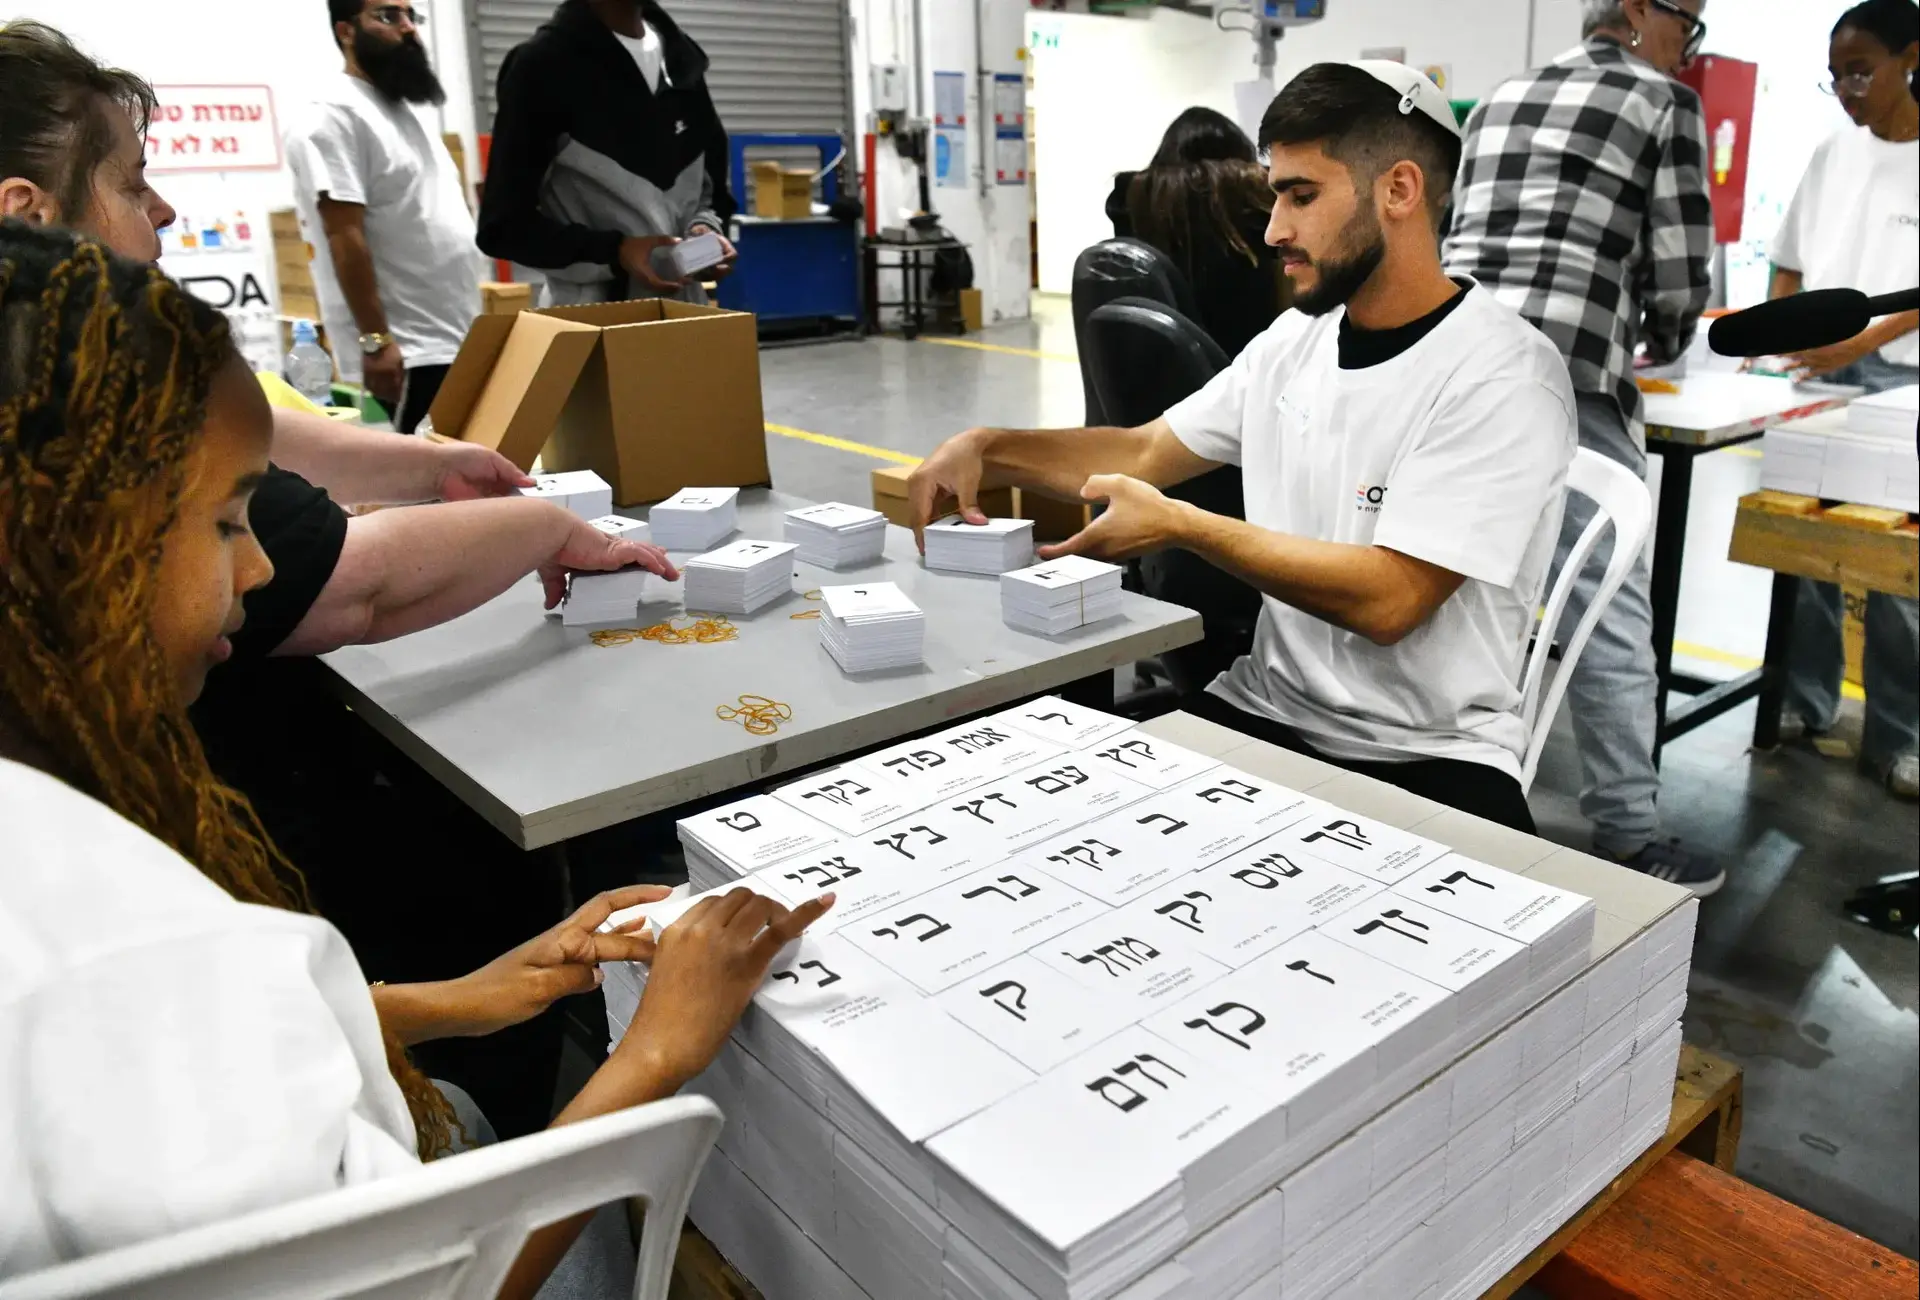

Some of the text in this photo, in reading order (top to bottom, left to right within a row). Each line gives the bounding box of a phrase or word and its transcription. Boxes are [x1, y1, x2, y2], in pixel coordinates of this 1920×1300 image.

[192, 104, 263, 122] עמדת
[171, 132, 201, 155] לא
[211, 135, 240, 154] נא
[1025, 712, 1073, 726] ל
[943, 725, 1011, 755] אמת
[1095, 740, 1156, 769] קץ
[879, 747, 947, 777] פה
[1024, 765, 1090, 795] עם
[1195, 779, 1262, 804] נף
[715, 811, 762, 833] ט
[951, 792, 1018, 825] זץ
[1135, 813, 1189, 836] ב
[873, 825, 948, 860] נץ
[1046, 838, 1123, 872] נקי
[783, 856, 863, 888] צבי
[1227, 850, 1304, 890] שס
[961, 874, 1041, 902] נר
[1153, 890, 1213, 934] יק
[871, 913, 952, 943] בי
[1061, 936, 1161, 978] מחל
[770, 957, 842, 988] ני
[1285, 960, 1335, 985] ז
[979, 980, 1027, 1022] ק
[1183, 1002, 1266, 1050] כן
